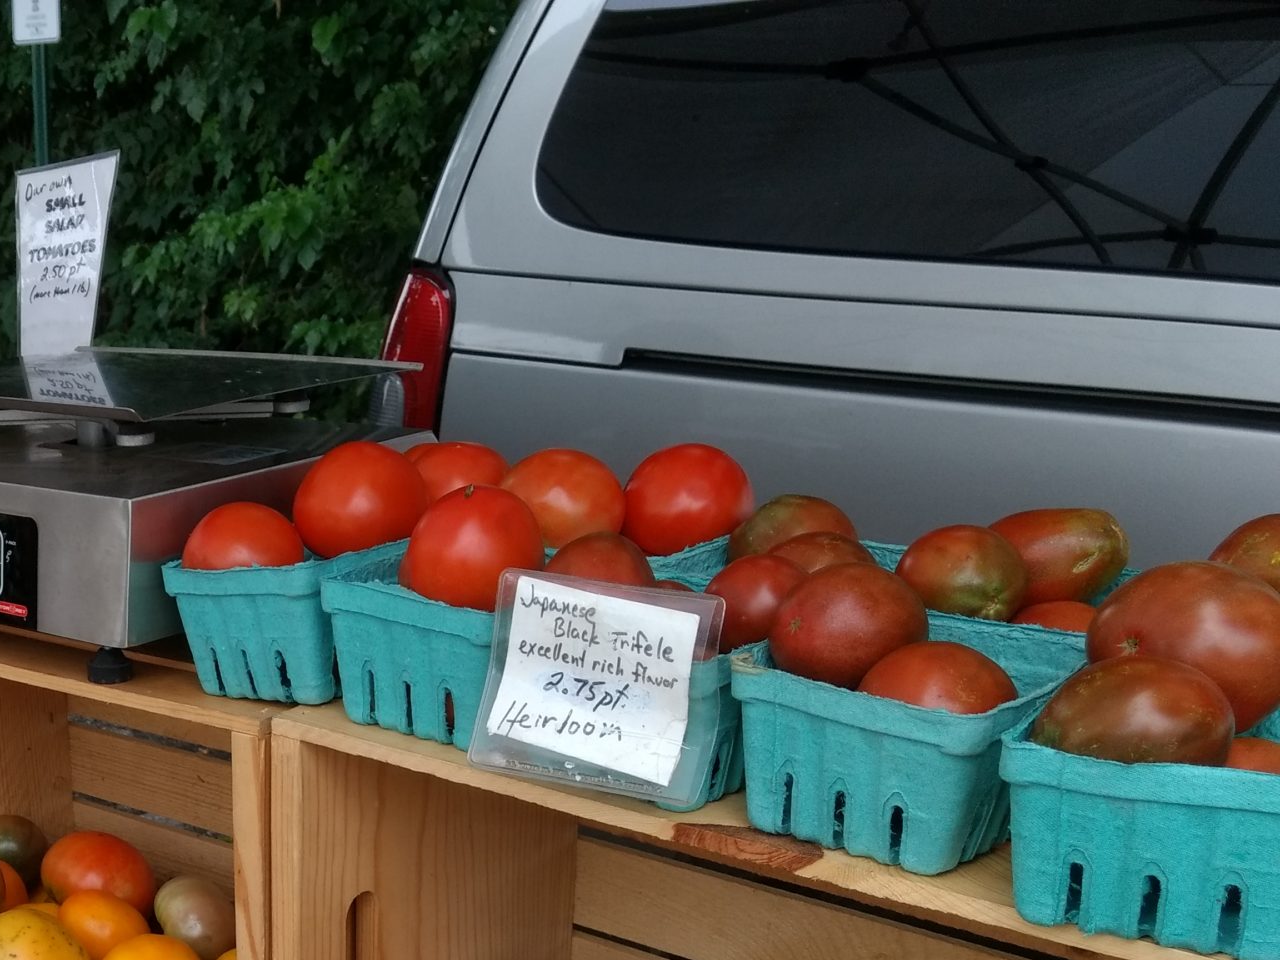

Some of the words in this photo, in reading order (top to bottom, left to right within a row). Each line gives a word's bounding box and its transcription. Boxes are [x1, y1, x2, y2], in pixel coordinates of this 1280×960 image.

[25, 182, 48, 202] Our
[48, 175, 73, 188] own
[45, 193, 86, 213] SMALL
[45, 214, 85, 234] SALAD
[28, 239, 96, 263] TOMATOES
[40, 264, 67, 281] 2.50
[66, 257, 86, 283] pt
[520, 584, 597, 625] Japanese
[553, 616, 600, 648] Black
[608, 630, 674, 663] Trifele
[518, 639, 587, 669] excellent
[592, 656, 624, 677] rich
[632, 661, 679, 690] flavor
[497, 700, 622, 741] Heirloom
